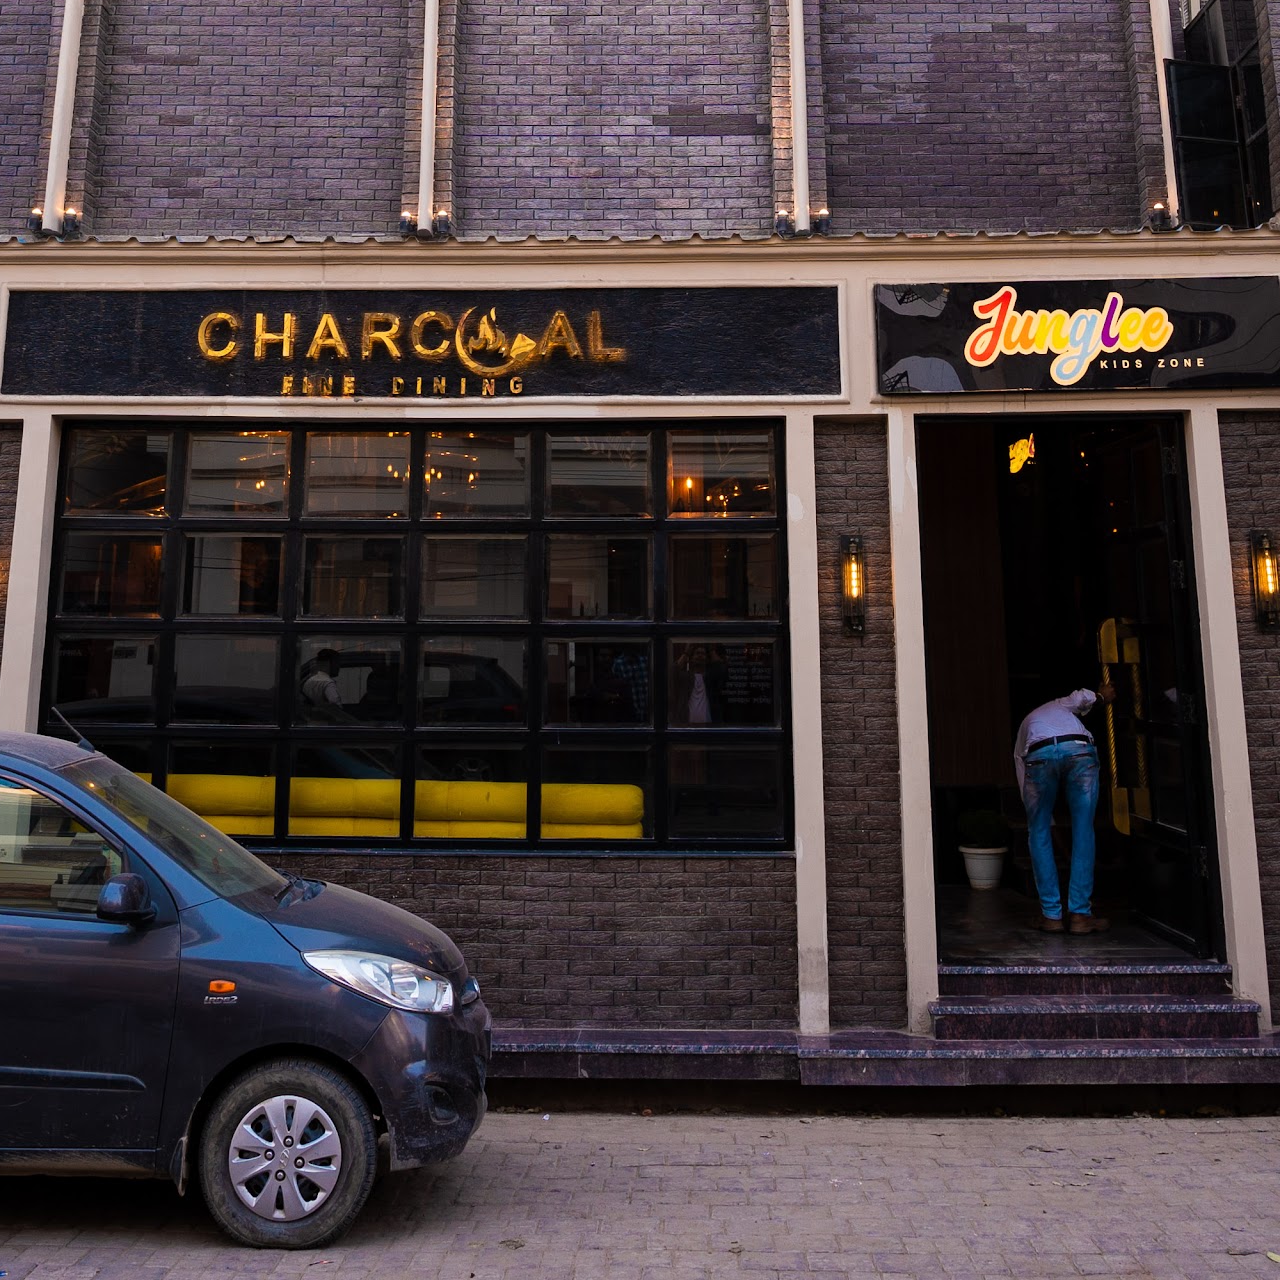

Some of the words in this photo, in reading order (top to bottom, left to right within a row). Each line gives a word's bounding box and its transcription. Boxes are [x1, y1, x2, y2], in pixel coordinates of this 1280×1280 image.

[963, 286, 1174, 386] Junglee
[1099, 360, 1143, 369] KIDS
[1157, 358, 1205, 368] ZONE
[282, 376, 356, 395] FINE
[392, 375, 523, 397] DINING
